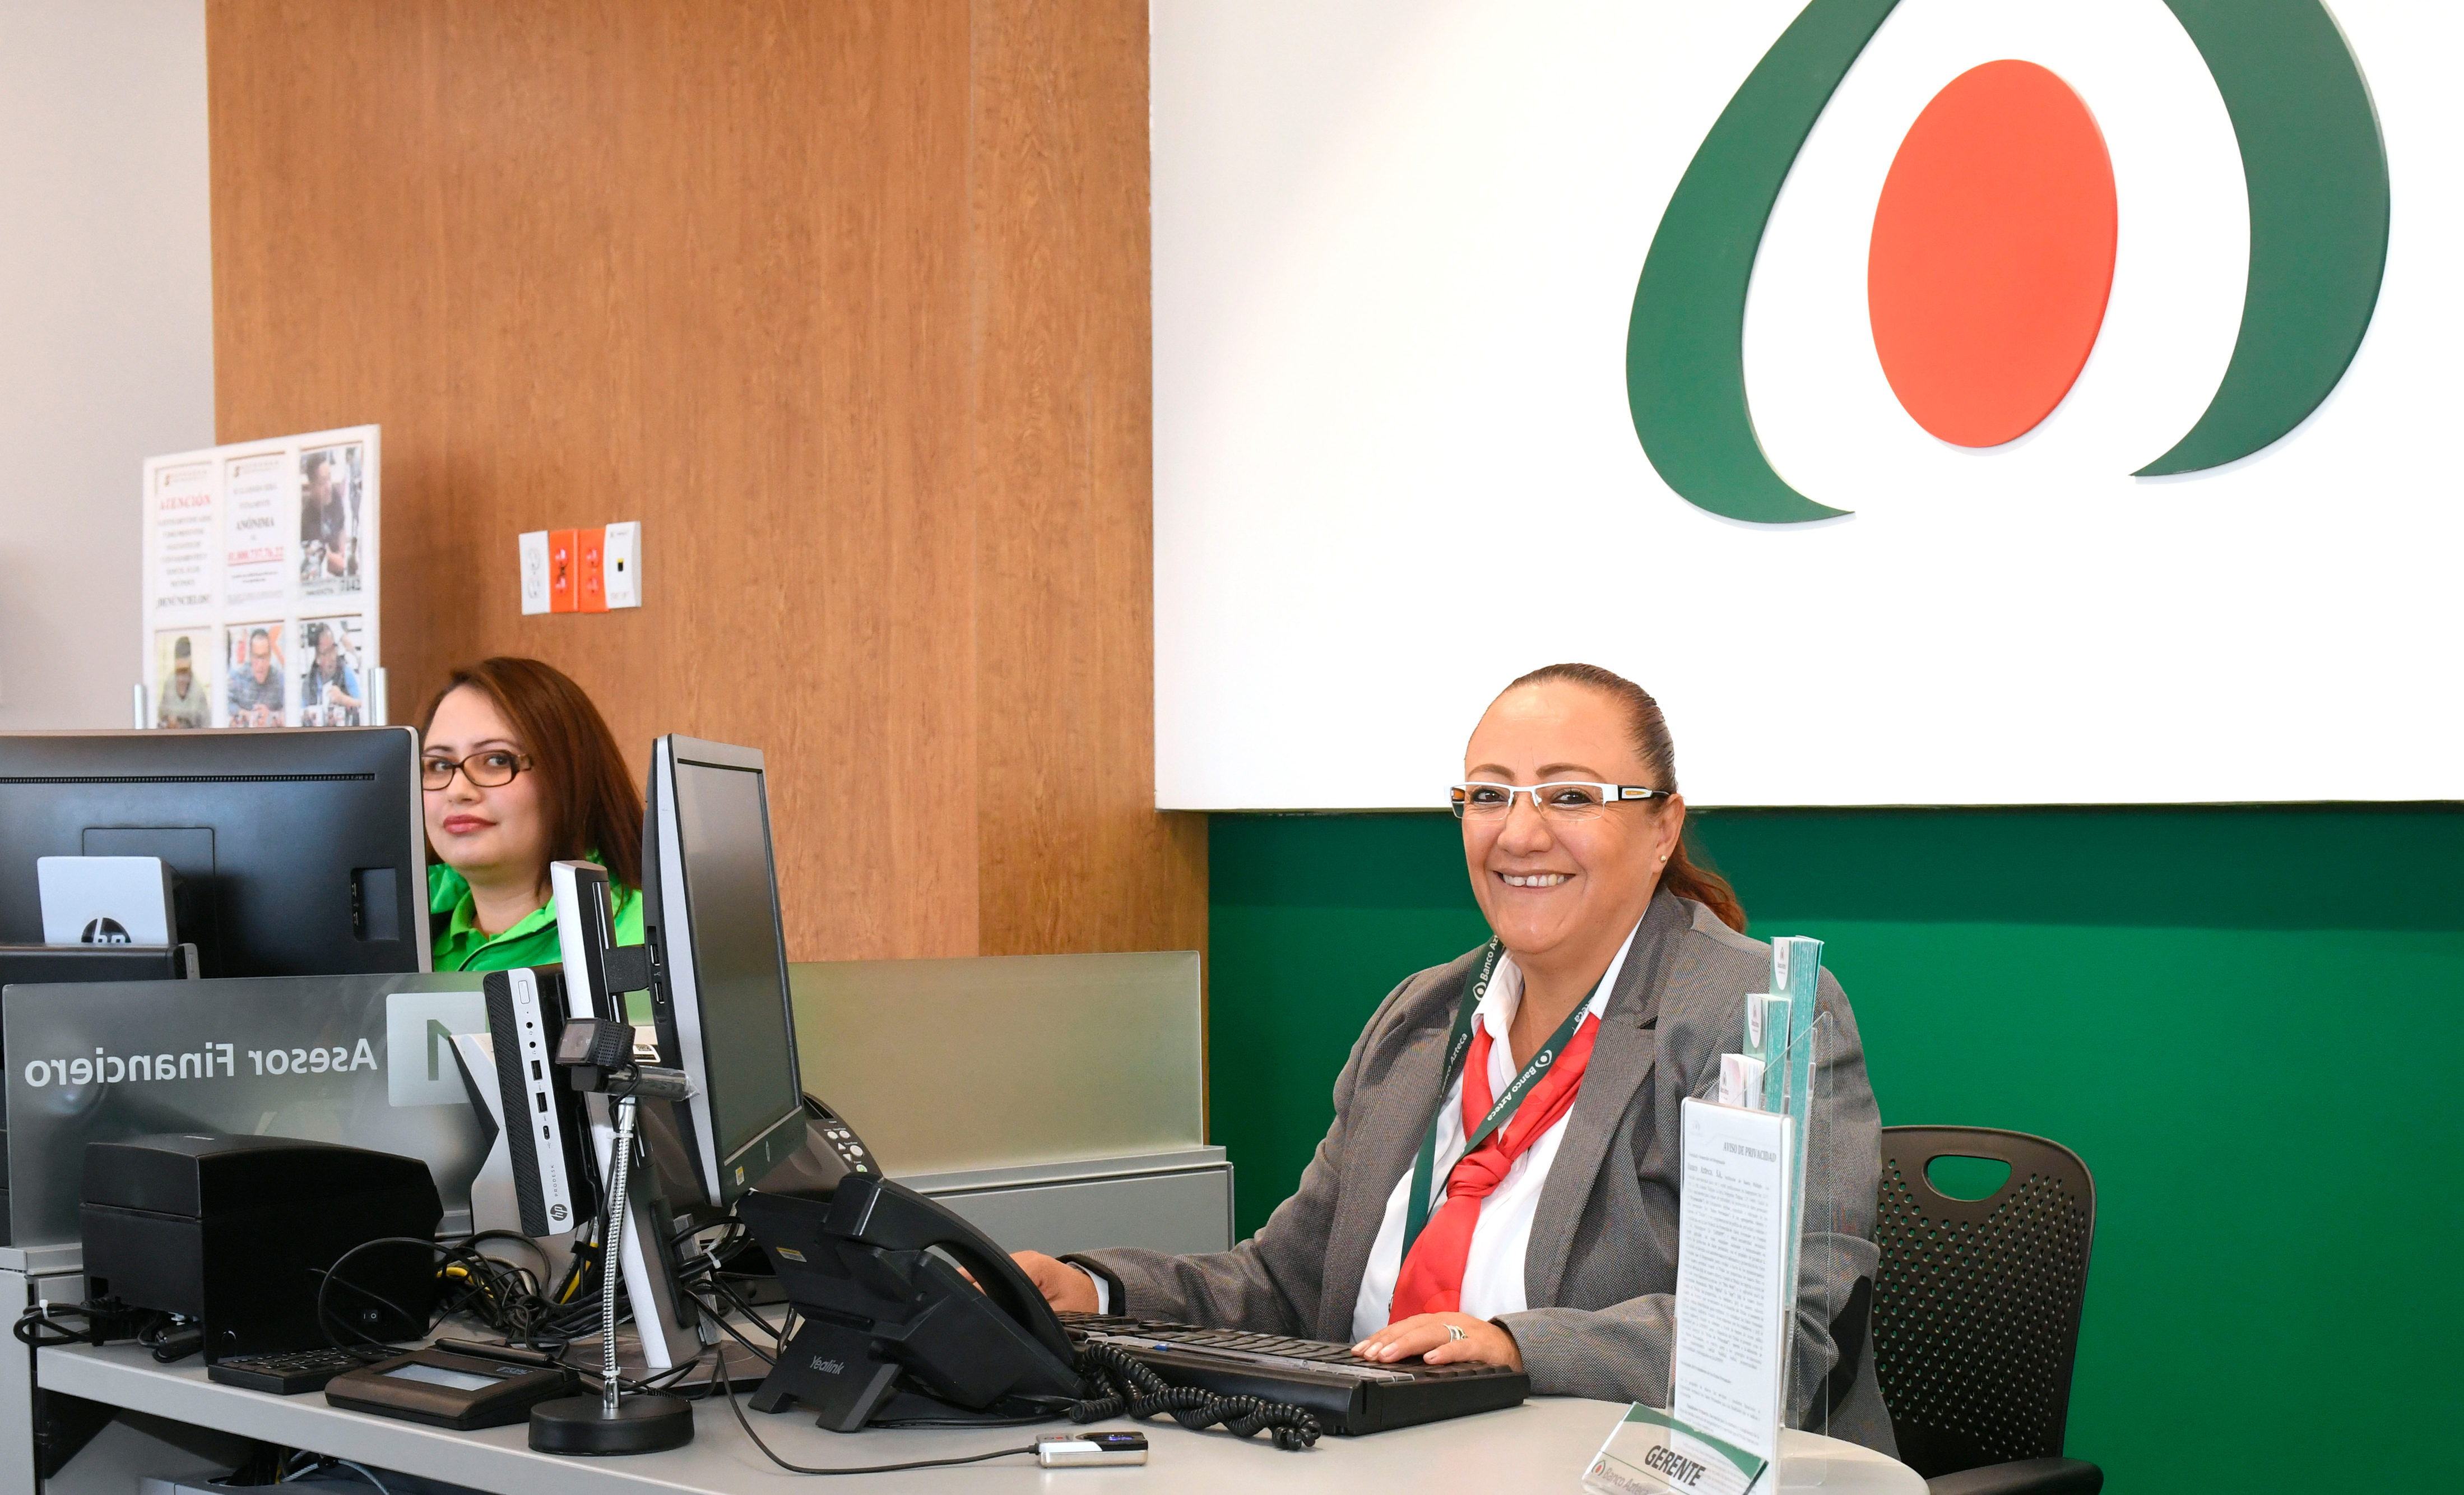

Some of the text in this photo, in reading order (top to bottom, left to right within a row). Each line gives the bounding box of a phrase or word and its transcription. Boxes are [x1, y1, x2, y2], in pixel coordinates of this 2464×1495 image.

[1480, 951, 1494, 981] Banco
[1450, 1033, 1468, 1066] Azteca
[1487, 1066, 1537, 1121] Banco Azteca
[1723, 1142, 1777, 1163] AVISO DE PRIVACIDAD
[810, 1355, 845, 1375] Yealink
[1602, 1467, 1625, 1487] Banco
[1645, 1445, 1706, 1487] GERENTE
